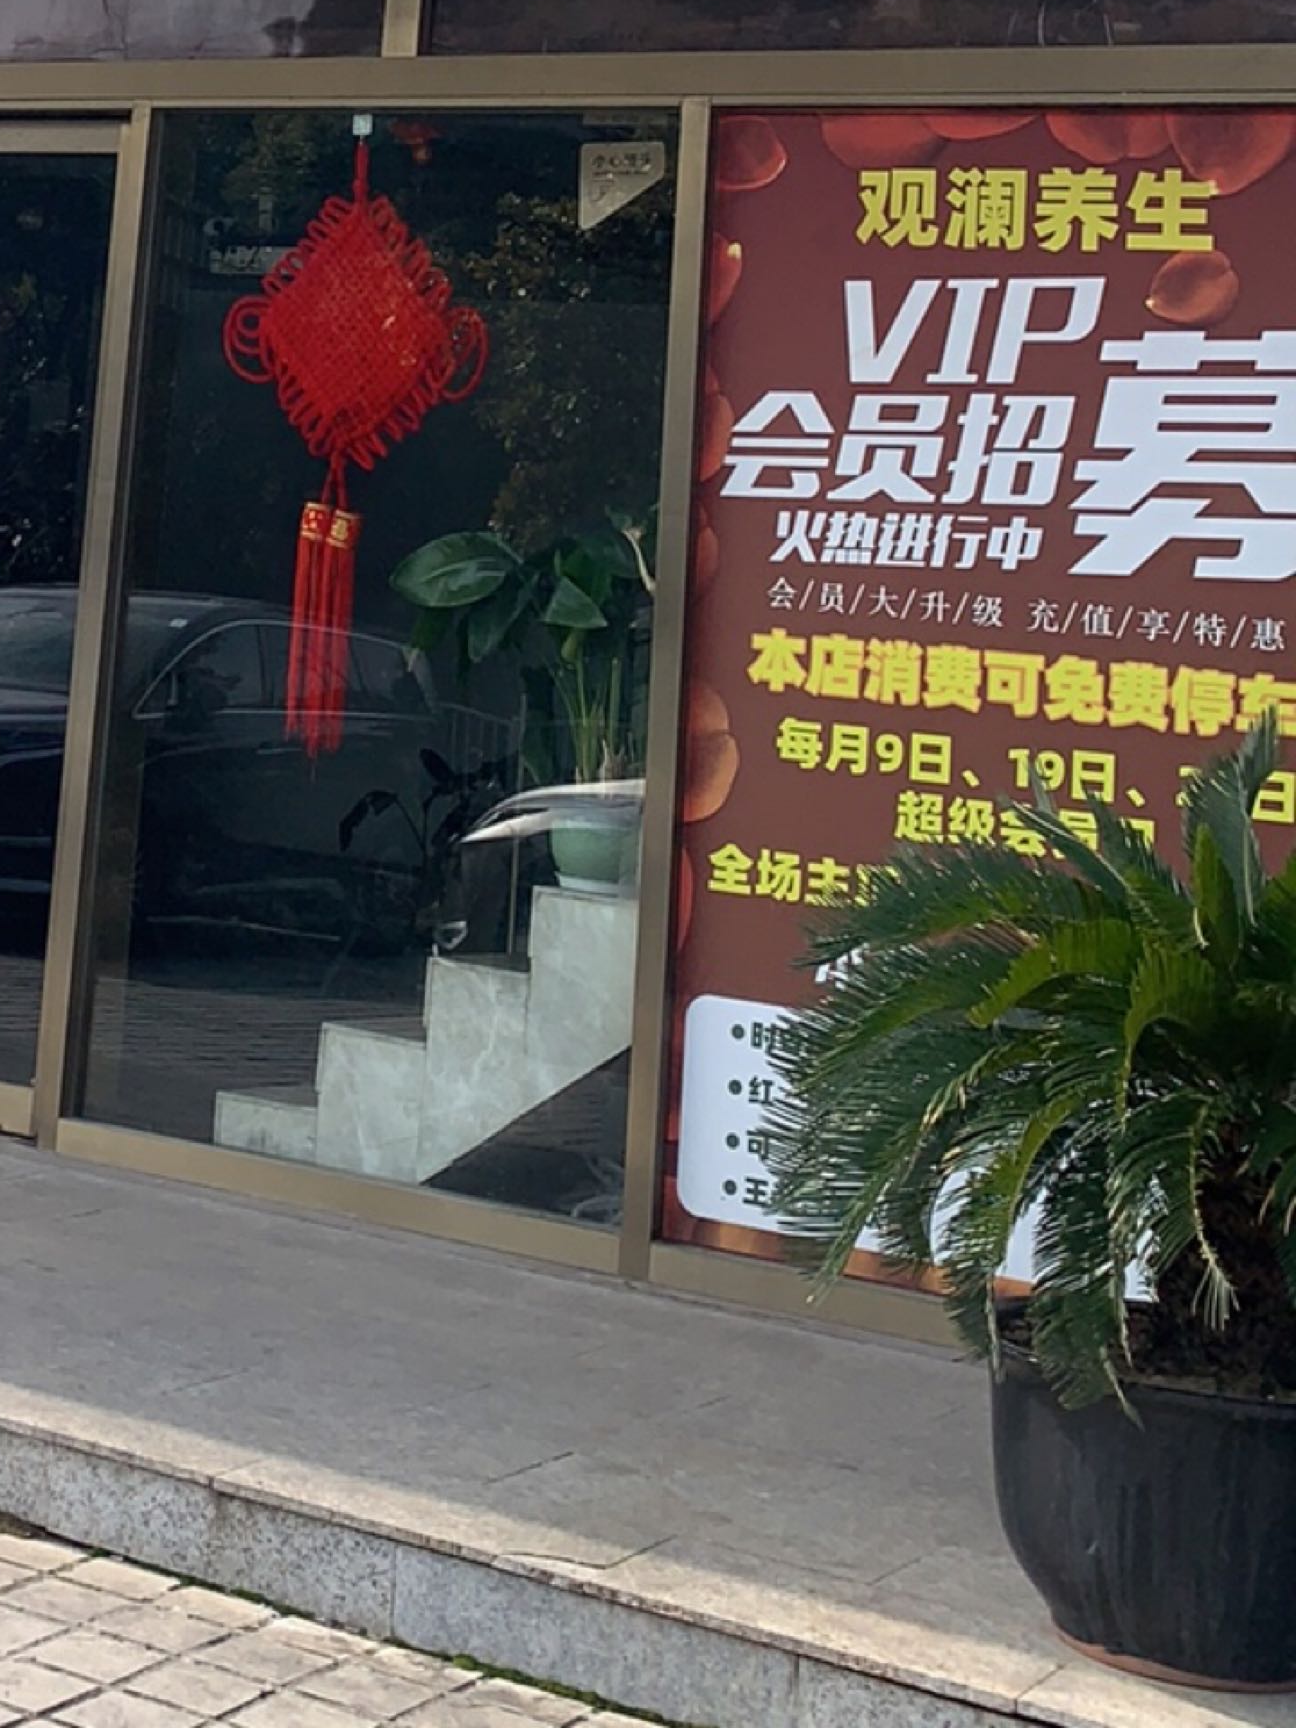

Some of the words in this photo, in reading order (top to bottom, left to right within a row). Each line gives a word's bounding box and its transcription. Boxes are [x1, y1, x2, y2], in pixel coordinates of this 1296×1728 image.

[856, 166, 1220, 253] 观澜养生
[843, 276, 1105, 385] VIP
[769, 510, 1044, 571] 火热进行中
